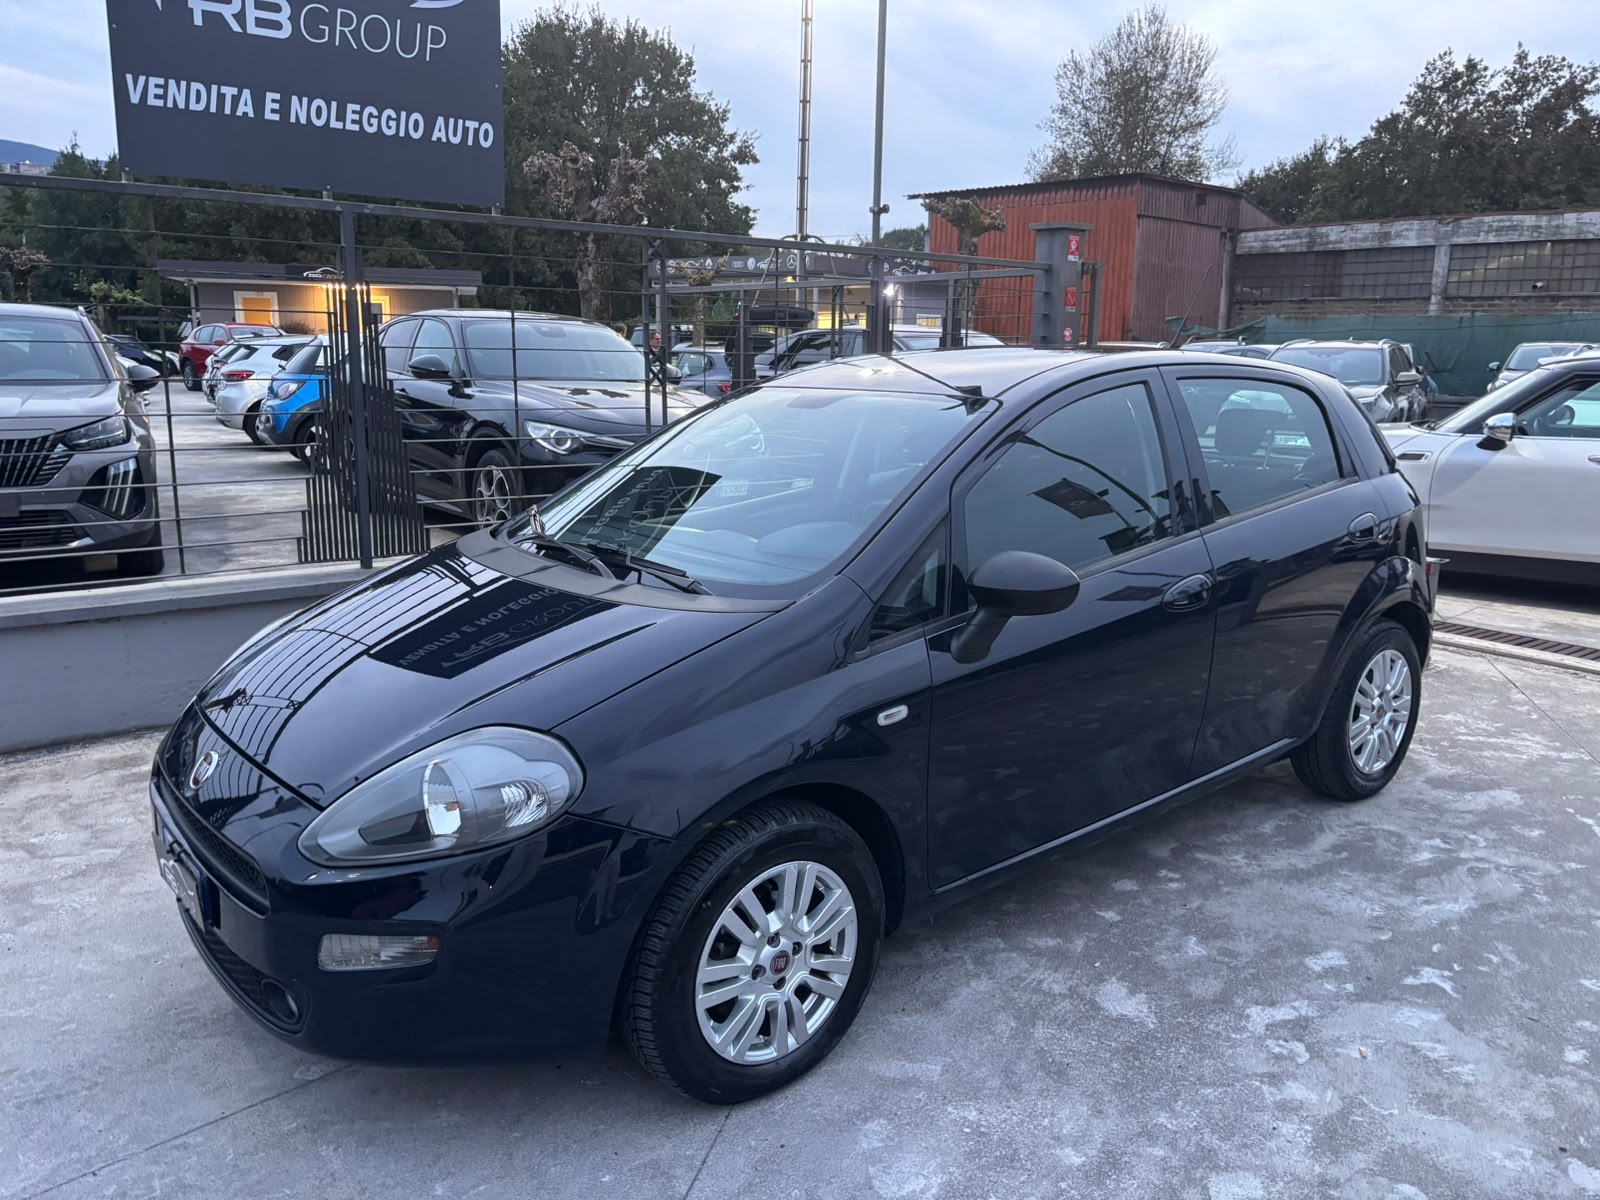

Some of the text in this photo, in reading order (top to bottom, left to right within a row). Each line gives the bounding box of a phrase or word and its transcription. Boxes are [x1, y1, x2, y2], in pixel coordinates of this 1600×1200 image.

[299, 3, 447, 62] GROUP
[125, 73, 495, 149] VENDITA E NOLEGGIO AUTO
